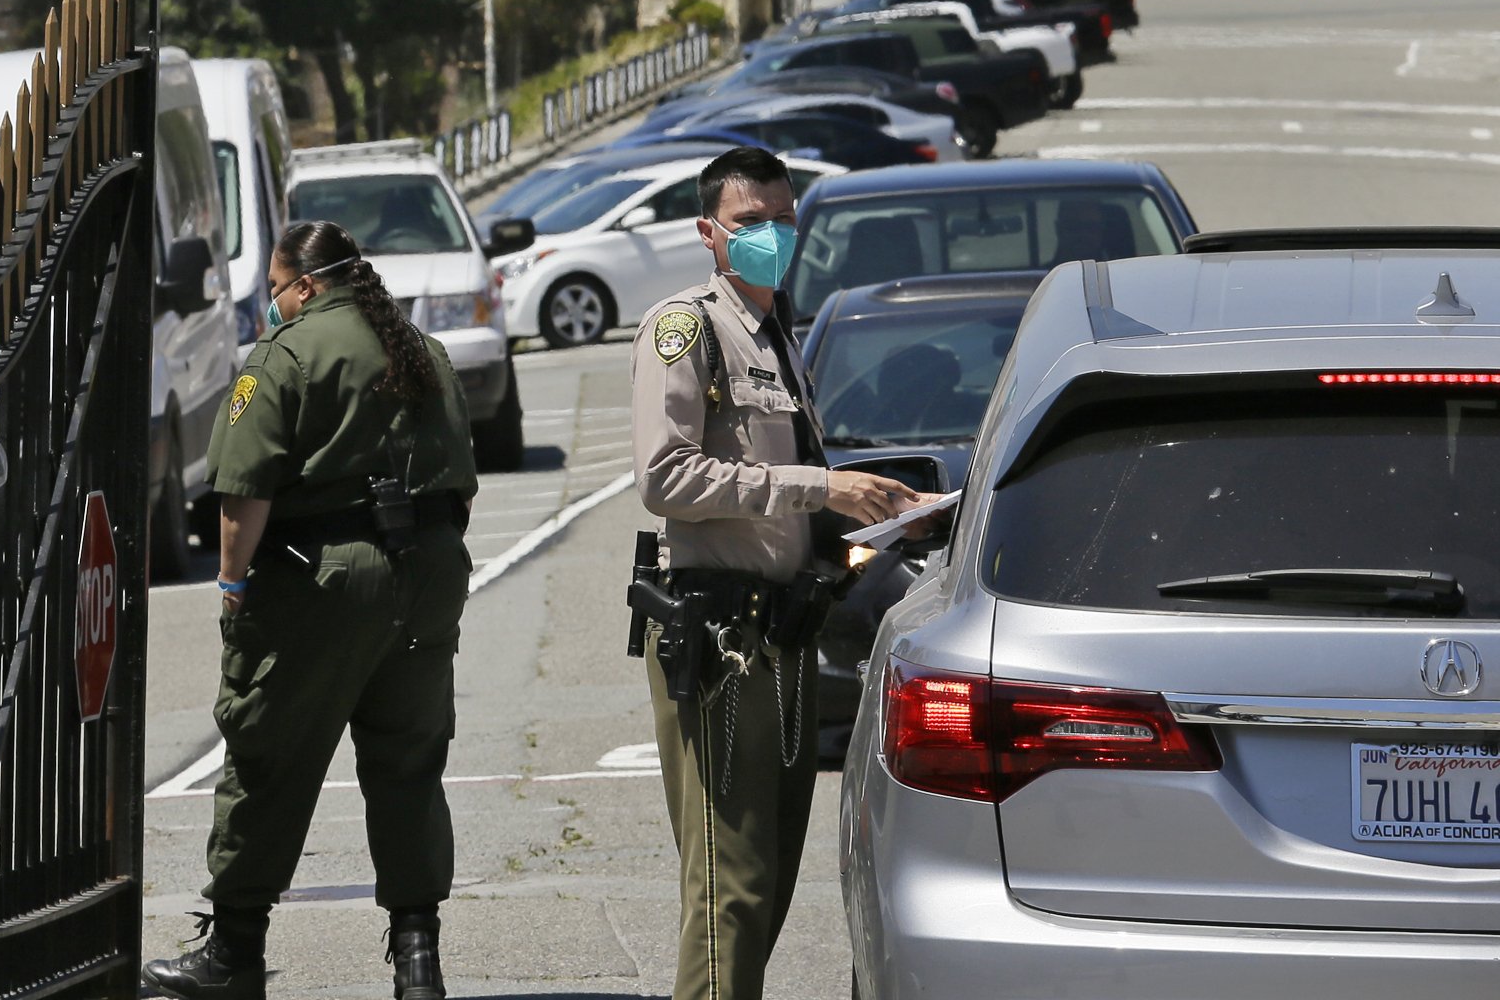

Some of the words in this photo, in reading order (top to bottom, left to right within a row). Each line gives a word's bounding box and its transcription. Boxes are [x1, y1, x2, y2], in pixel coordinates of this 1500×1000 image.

[77, 563, 114, 650] STOP
[1362, 750, 1388, 764] JUN
[1371, 825, 1425, 838] ACURA
[1426, 827, 1441, 837] OF
